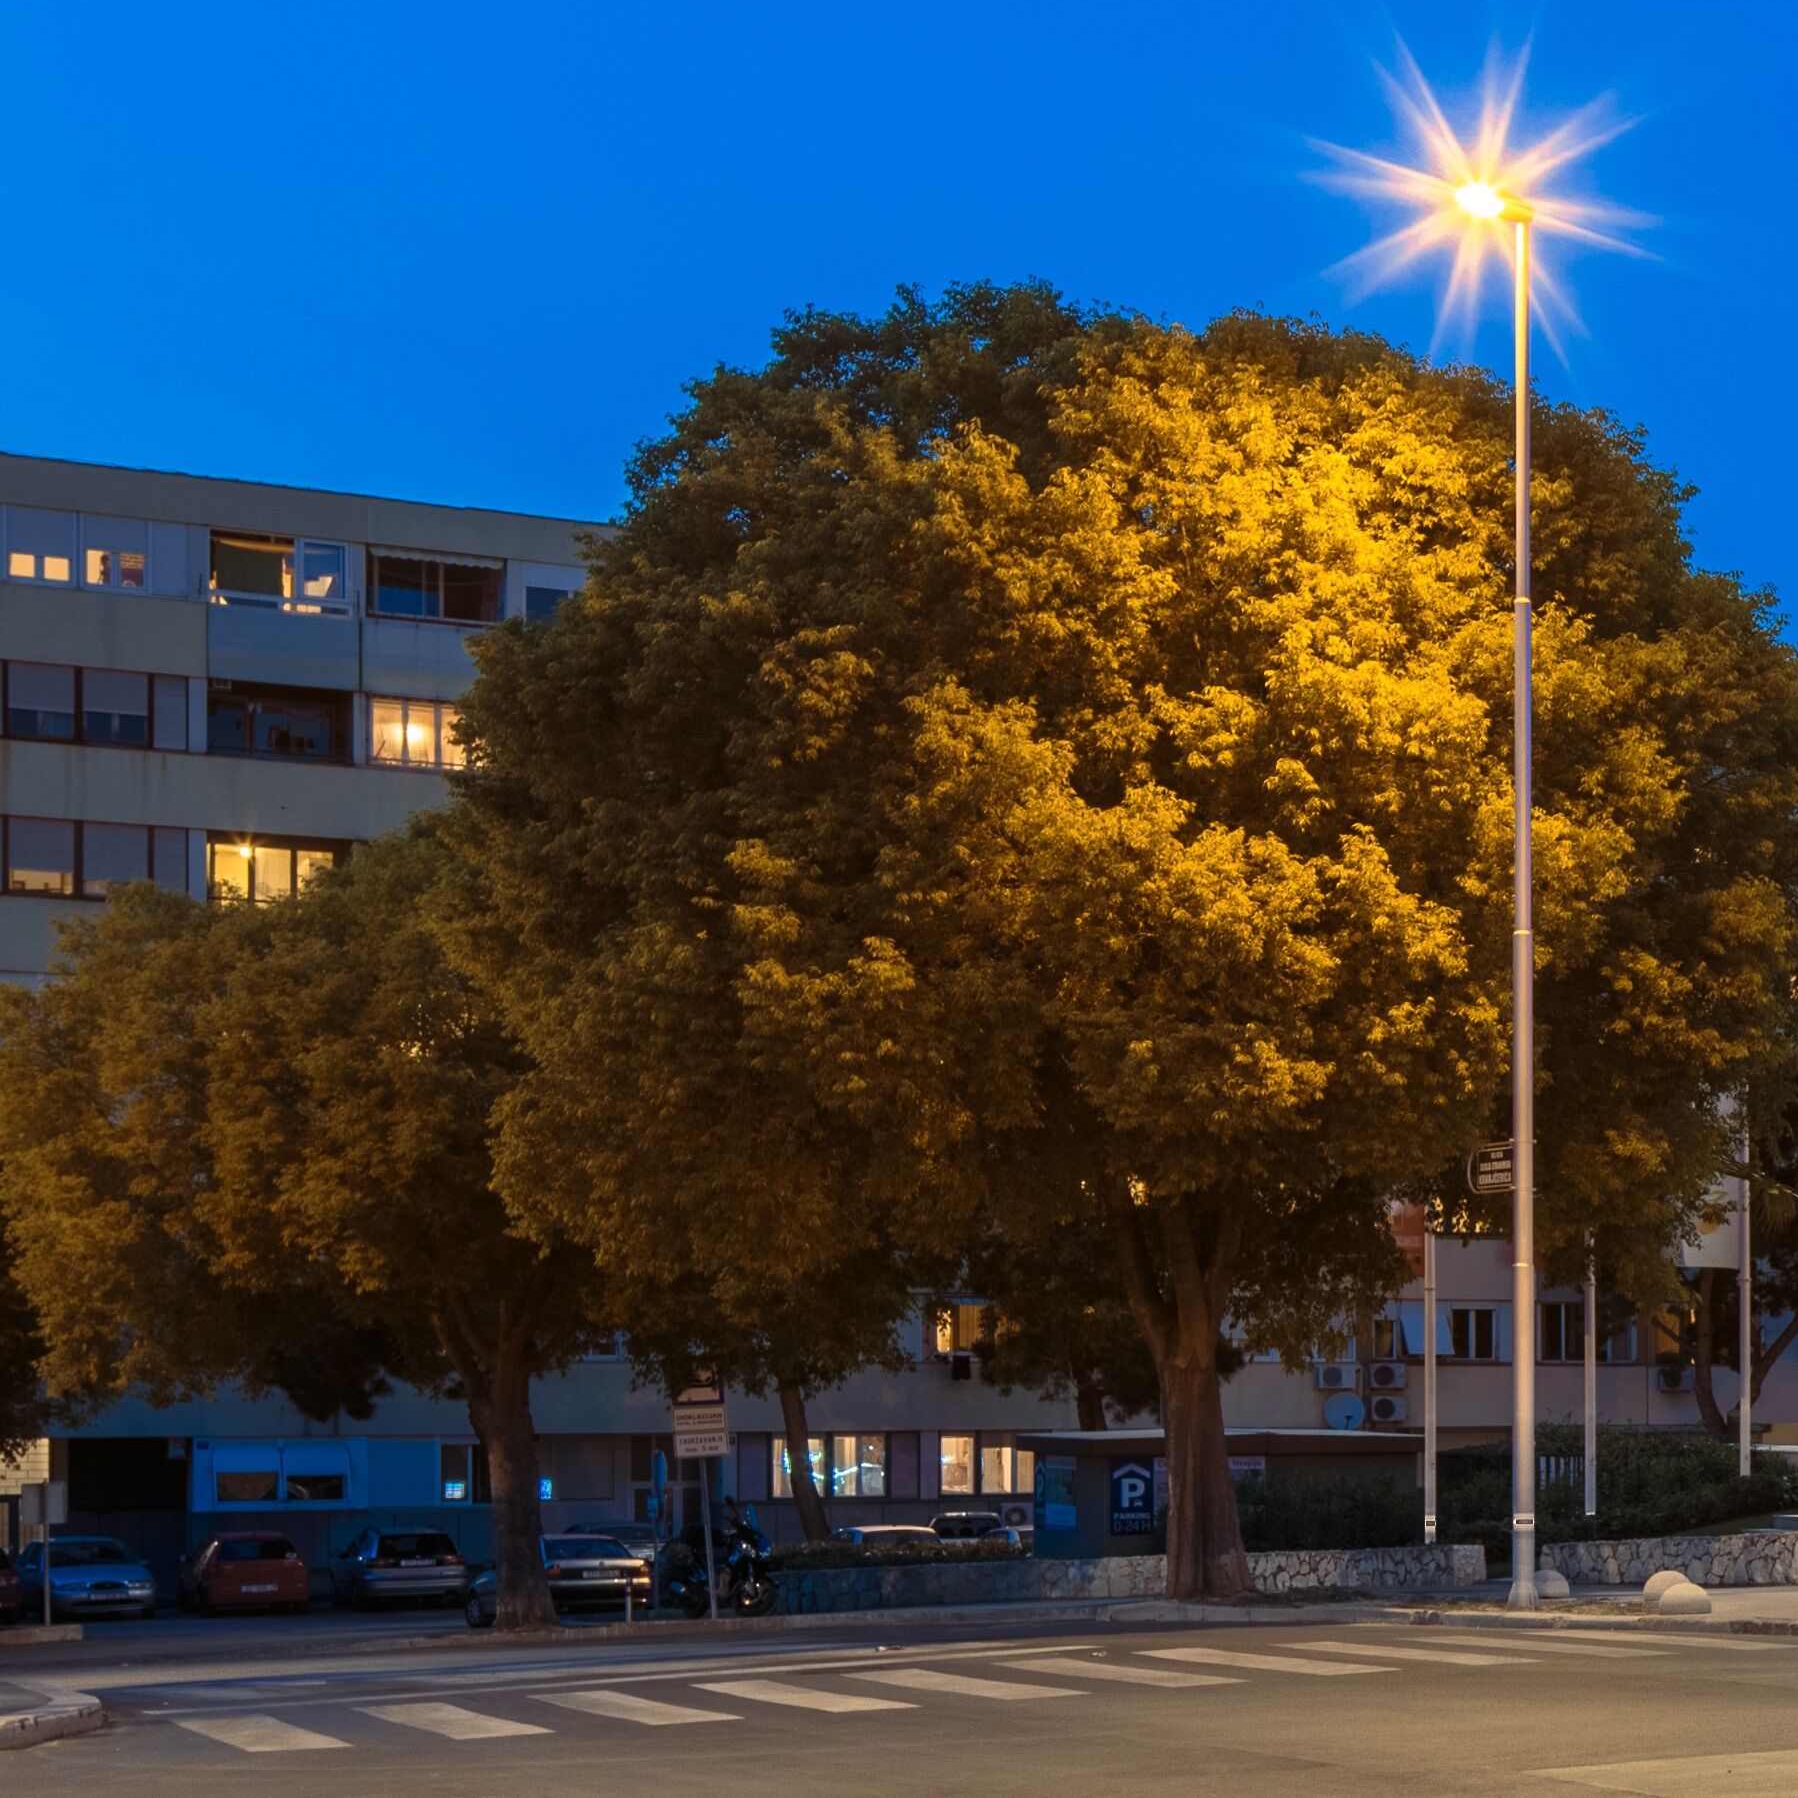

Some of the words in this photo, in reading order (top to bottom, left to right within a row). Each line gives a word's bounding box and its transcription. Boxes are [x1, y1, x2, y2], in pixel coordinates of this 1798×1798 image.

[1120, 1477, 1146, 1509] P
[1113, 1512, 1151, 1521] PARKING
[1113, 1521, 1141, 1532] 0-24
[1141, 1519, 1152, 1531] H
